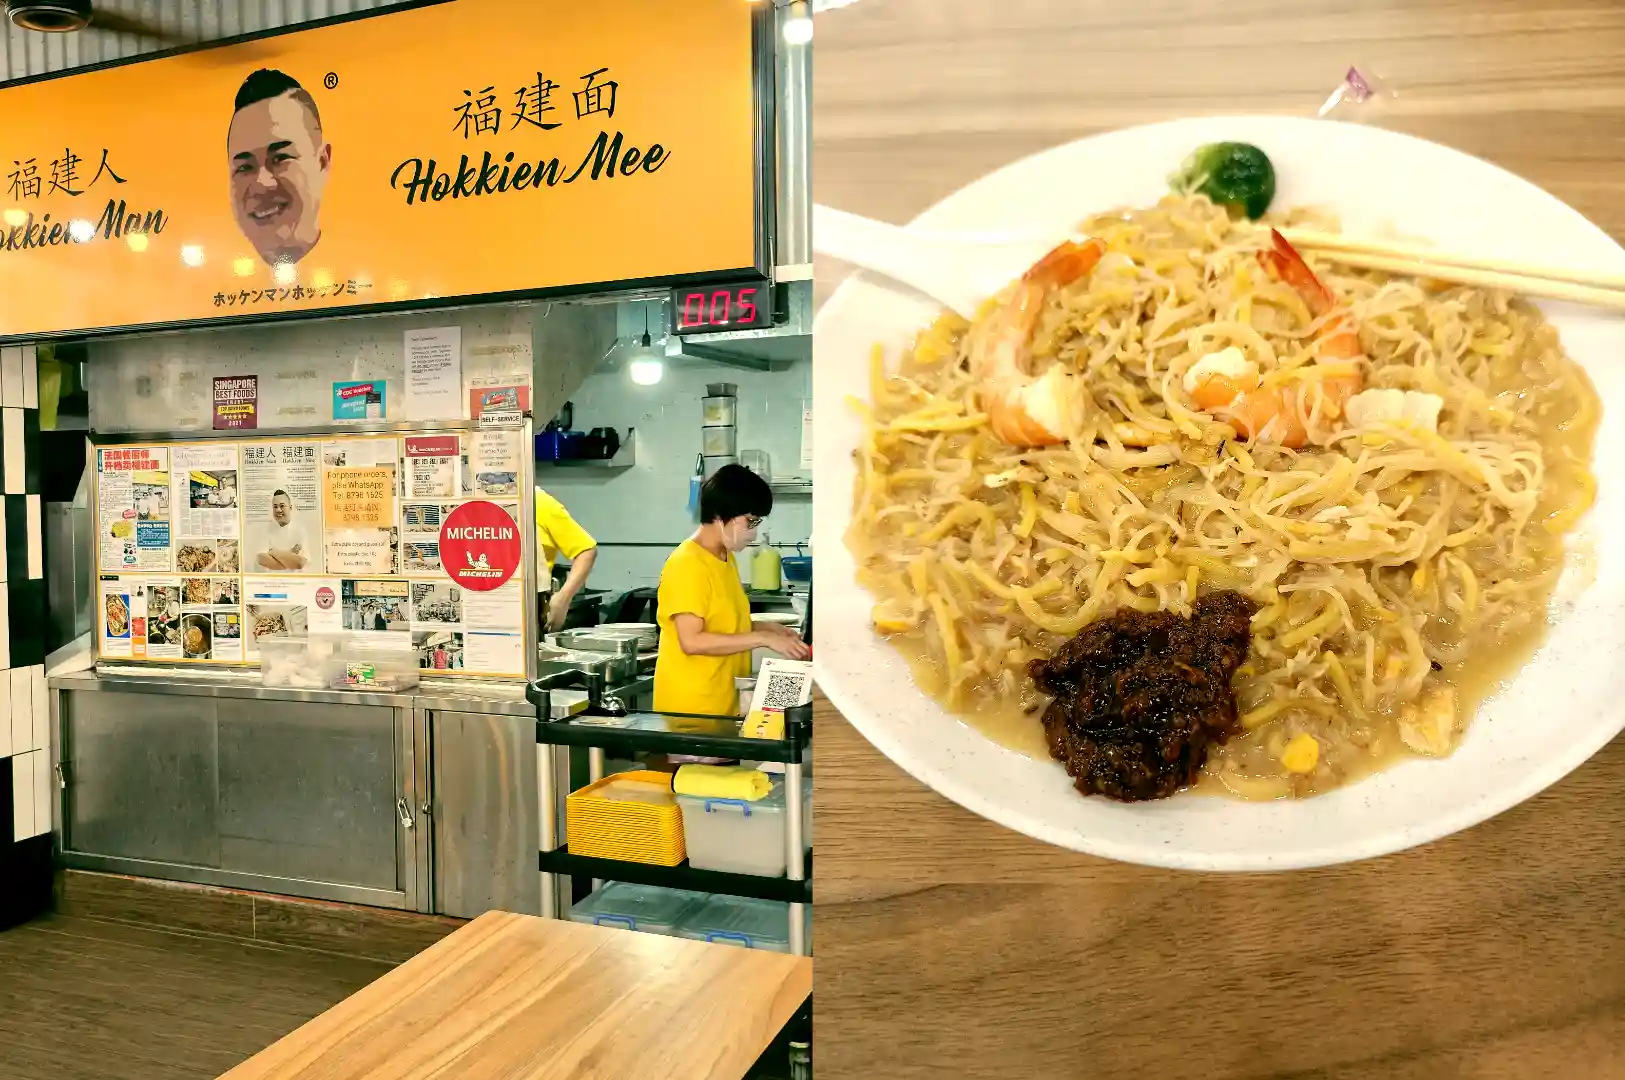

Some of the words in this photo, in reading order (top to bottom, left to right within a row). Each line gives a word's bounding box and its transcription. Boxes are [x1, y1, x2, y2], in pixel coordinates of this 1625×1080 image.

[452, 67, 619, 140] 福建面
[390, 151, 567, 205] Hokkien
[562, 130, 671, 183] Mee
[7, 148, 128, 201] 福建人
[94, 199, 169, 240] Man
[682, 288, 758, 327] 005
[214, 379, 256, 390] SINGAPORE
[215, 390, 231, 399] BEST
[233, 389, 255, 398] FOODS
[482, 415, 520, 423] SELF-SERVICE
[244, 447, 276, 459] 福建人
[282, 446, 315, 458] 福建面
[348, 480, 384, 489] WhatsApp
[447, 527, 513, 540] MICHELIN
